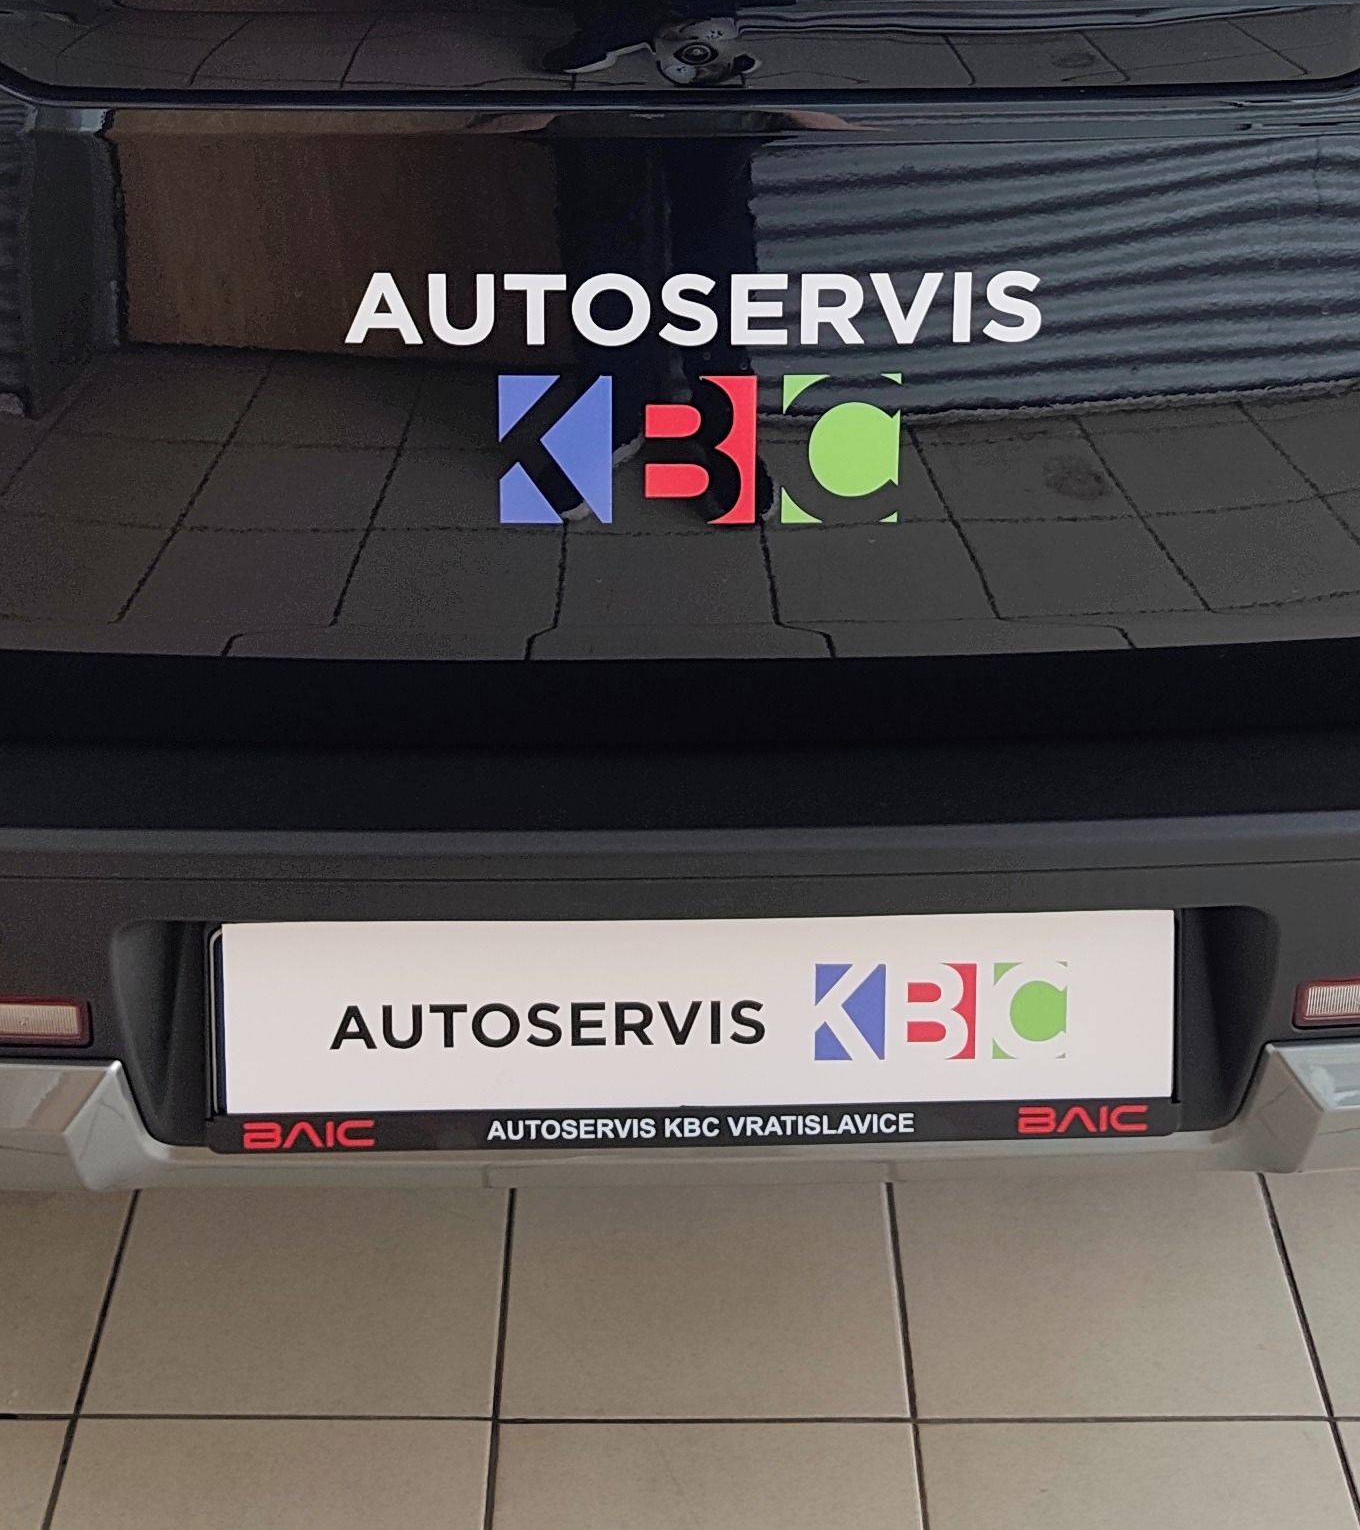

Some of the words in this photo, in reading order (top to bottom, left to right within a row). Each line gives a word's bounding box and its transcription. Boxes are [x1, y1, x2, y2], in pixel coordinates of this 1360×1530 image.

[344, 270, 1043, 347] AUTOSERVIS
[497, 373, 903, 525] KBC
[329, 999, 767, 1051] AUTOSERVIS
[814, 961, 1069, 1061] KBC
[242, 1118, 376, 1151] BAIC
[486, 1118, 657, 1141] AUTOSERVIS
[664, 1116, 720, 1139] KBC
[727, 1112, 916, 1137] VRATISLAVICE
[1016, 1104, 1150, 1136] BAIC
